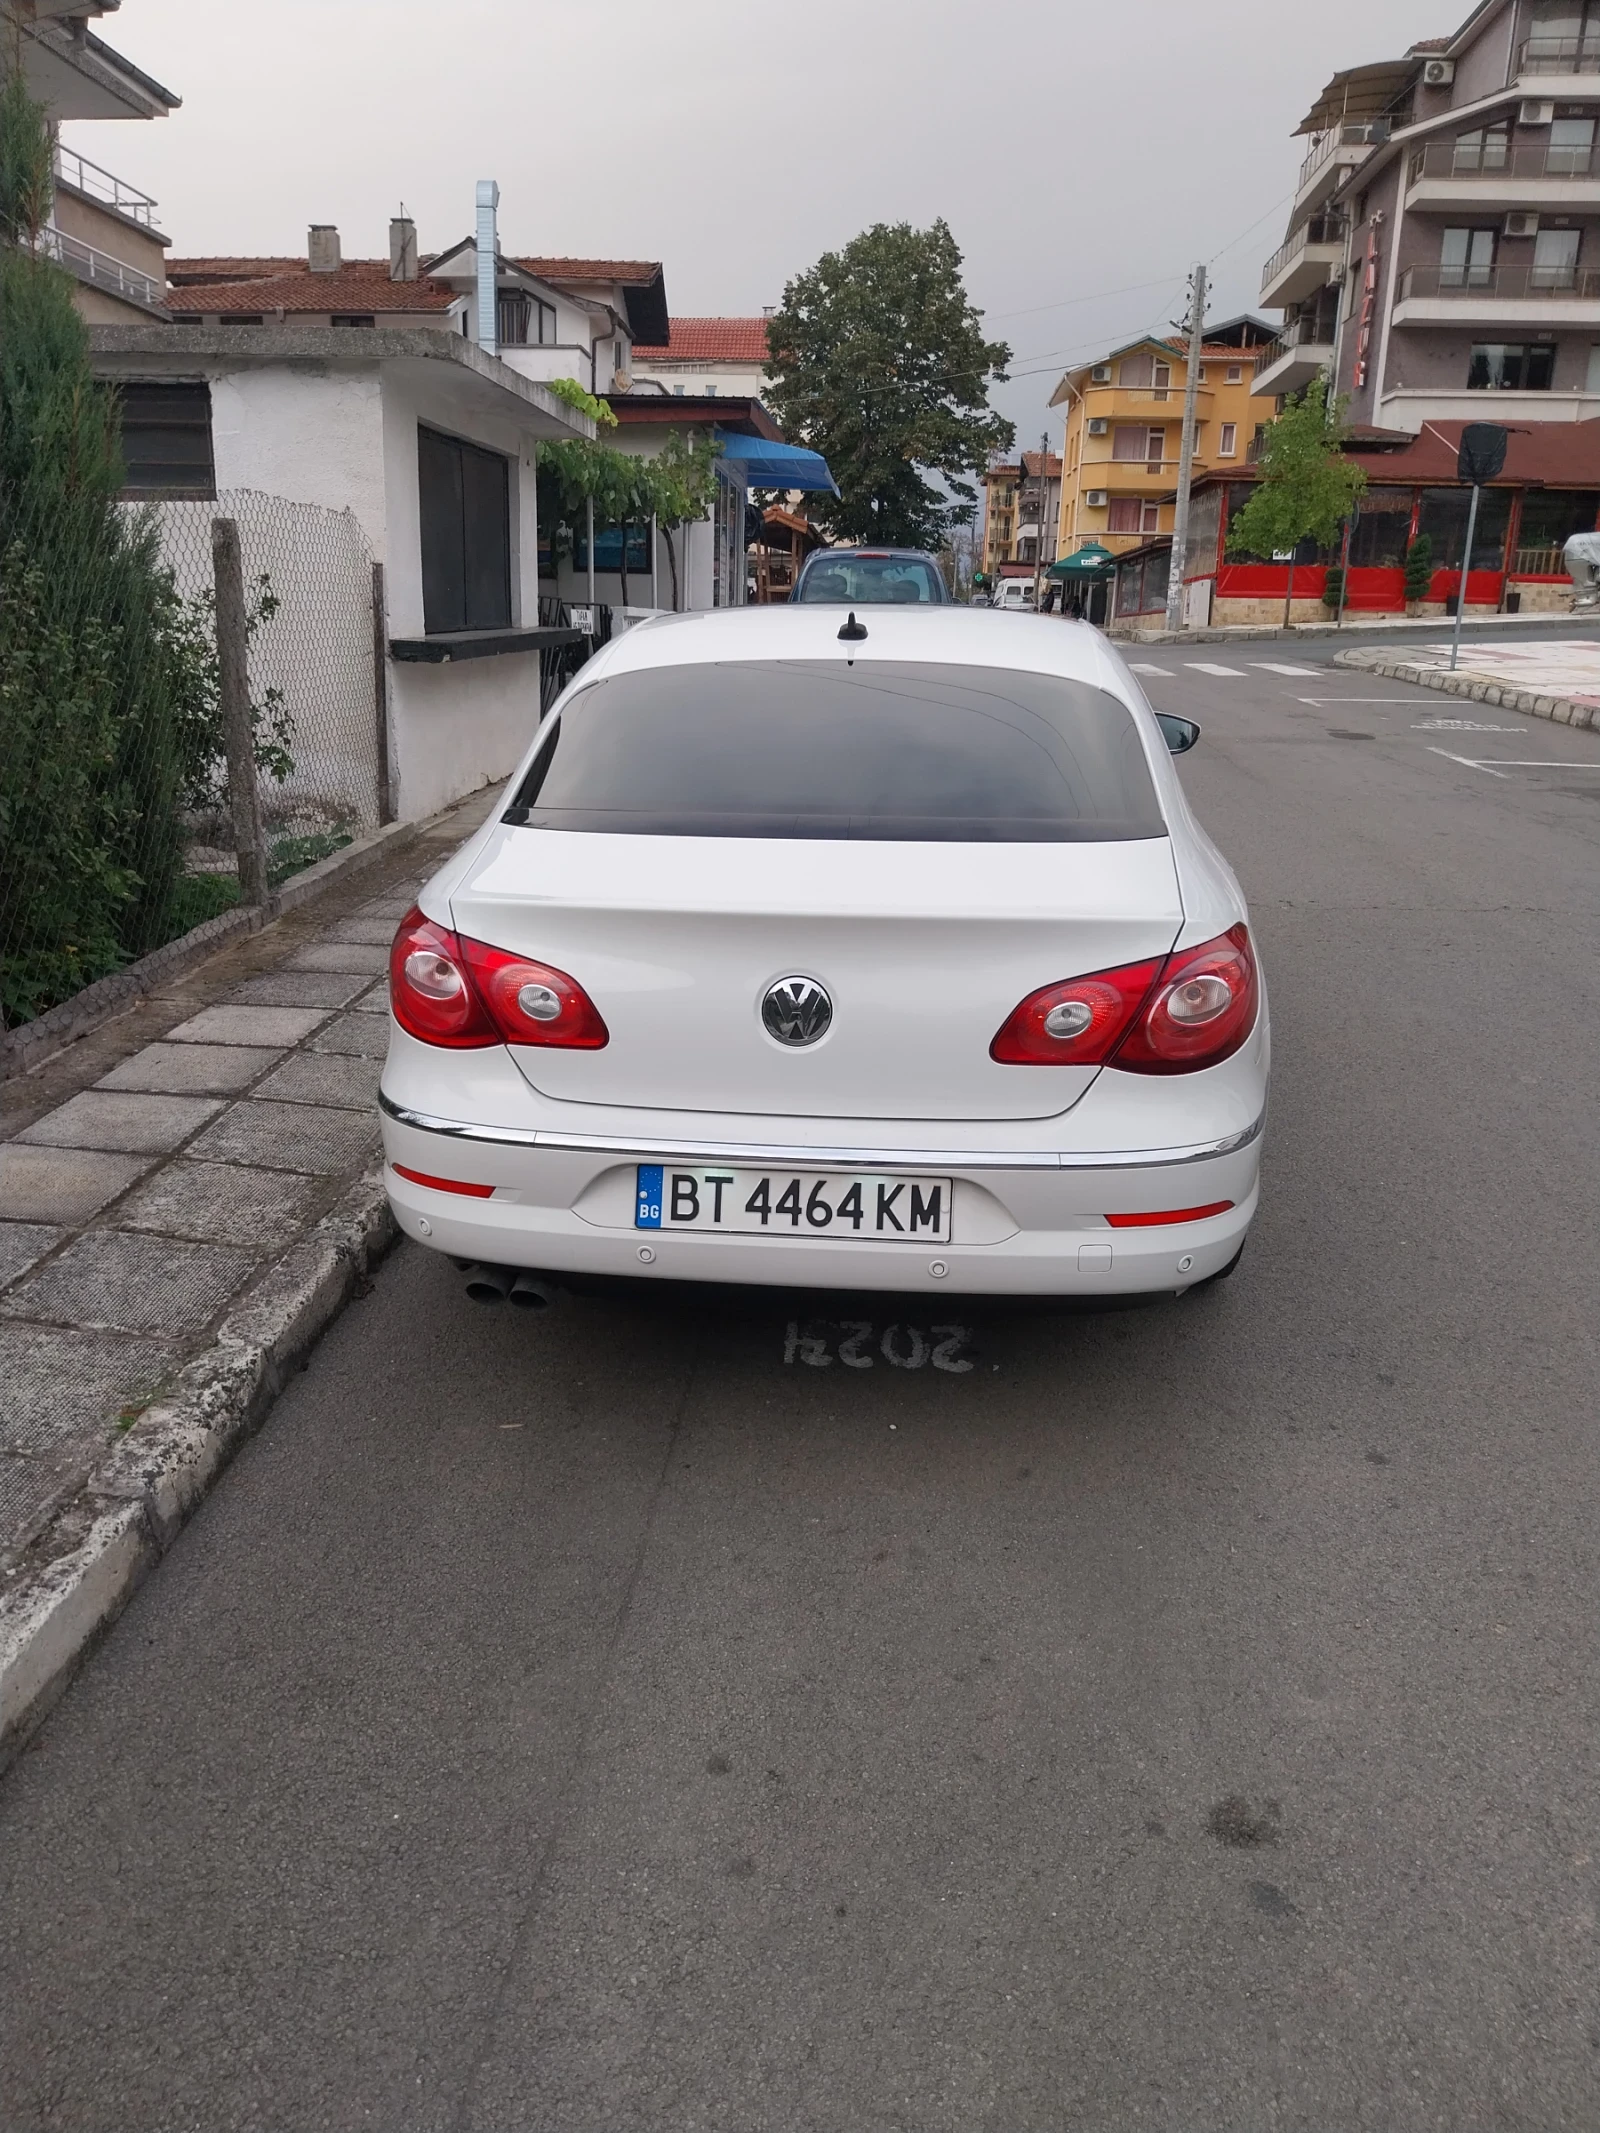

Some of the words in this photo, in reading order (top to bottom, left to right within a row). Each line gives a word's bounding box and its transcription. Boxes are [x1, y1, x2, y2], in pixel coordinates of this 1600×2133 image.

[1353, 232, 1379, 389] LAZUR
[639, 1204, 660, 1219] BG
[670, 1174, 734, 1223] BT
[745, 1178, 864, 1231] 4464
[876, 1183, 942, 1234] KM
